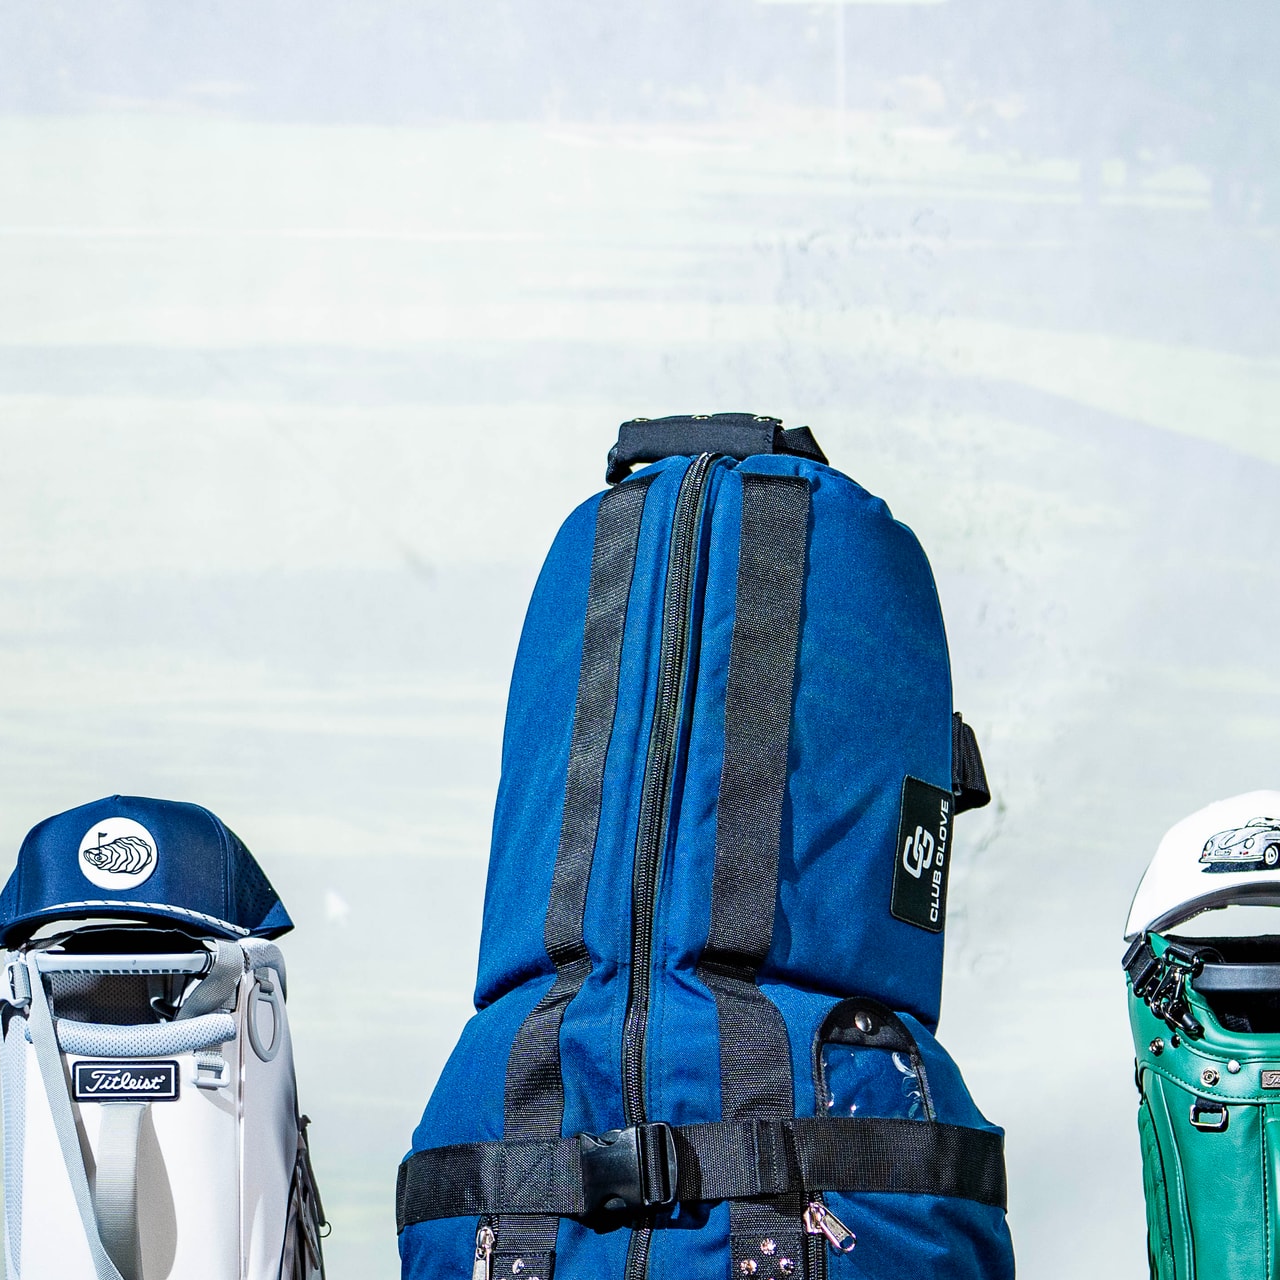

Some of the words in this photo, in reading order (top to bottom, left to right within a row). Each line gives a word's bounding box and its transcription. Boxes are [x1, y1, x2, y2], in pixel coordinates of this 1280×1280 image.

[934, 799, 950, 867] GLOVE
[929, 870, 943, 923] CLUB
[85, 1070, 166, 1093] Titleist
